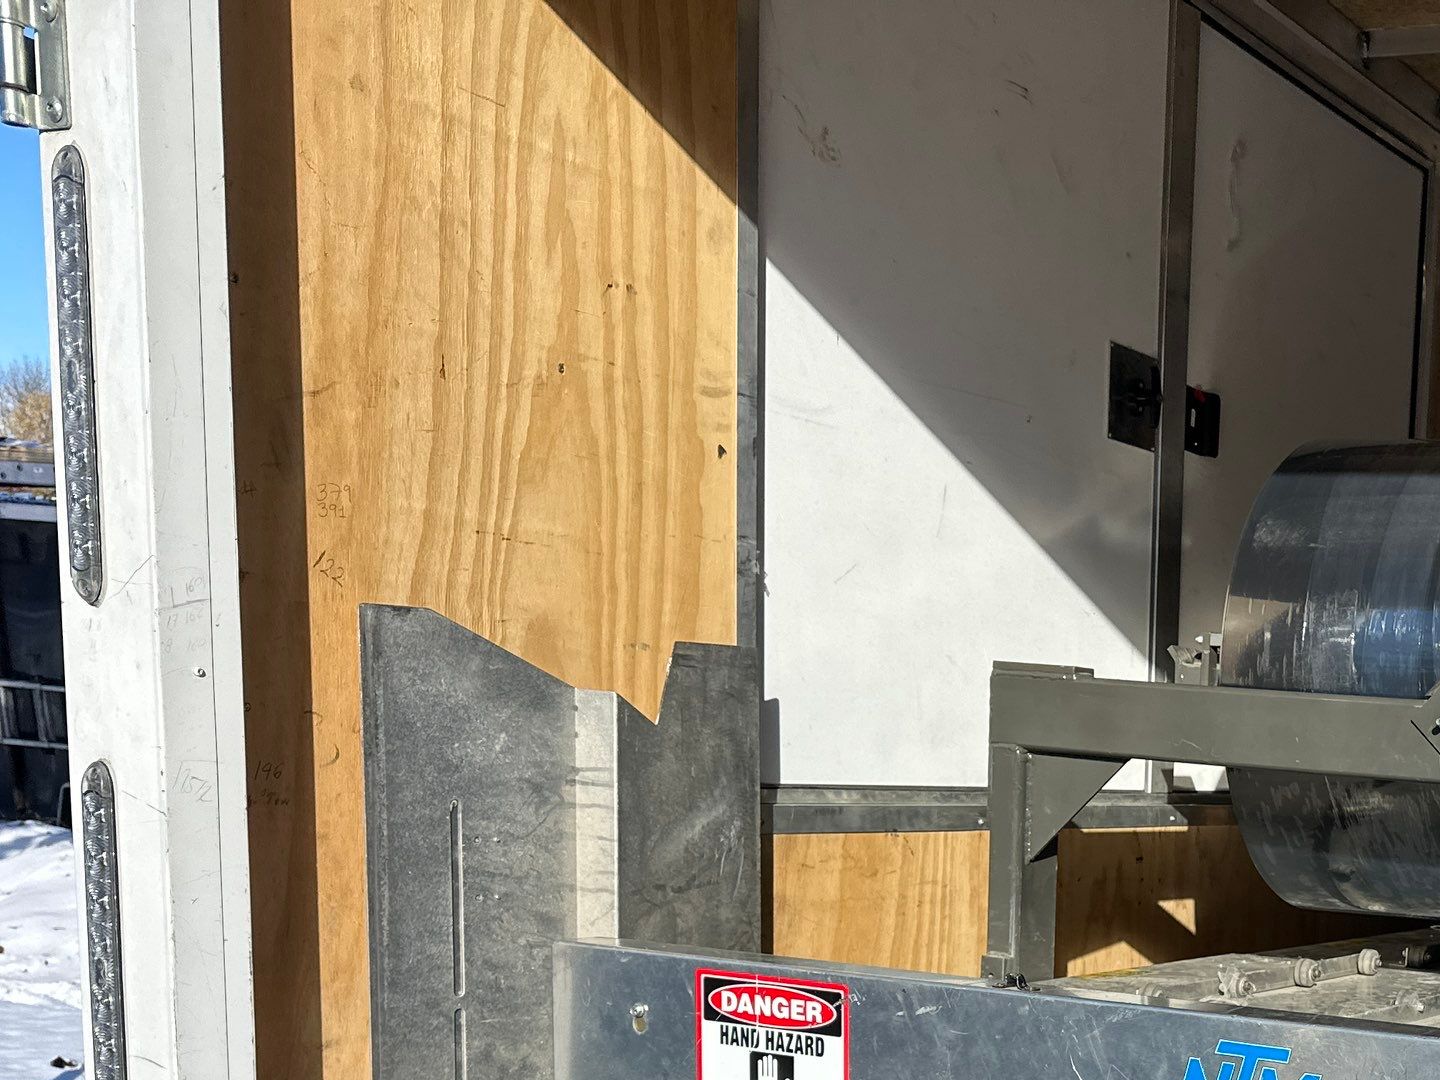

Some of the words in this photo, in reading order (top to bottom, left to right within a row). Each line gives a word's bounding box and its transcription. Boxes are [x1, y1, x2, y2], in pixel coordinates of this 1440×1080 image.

[316, 483, 351, 503] 379
[317, 502, 346, 518] 391
[720, 990, 823, 1024] DANGER
[720, 1024, 760, 1049] HAND
[766, 1030, 825, 1058] HAZARD
